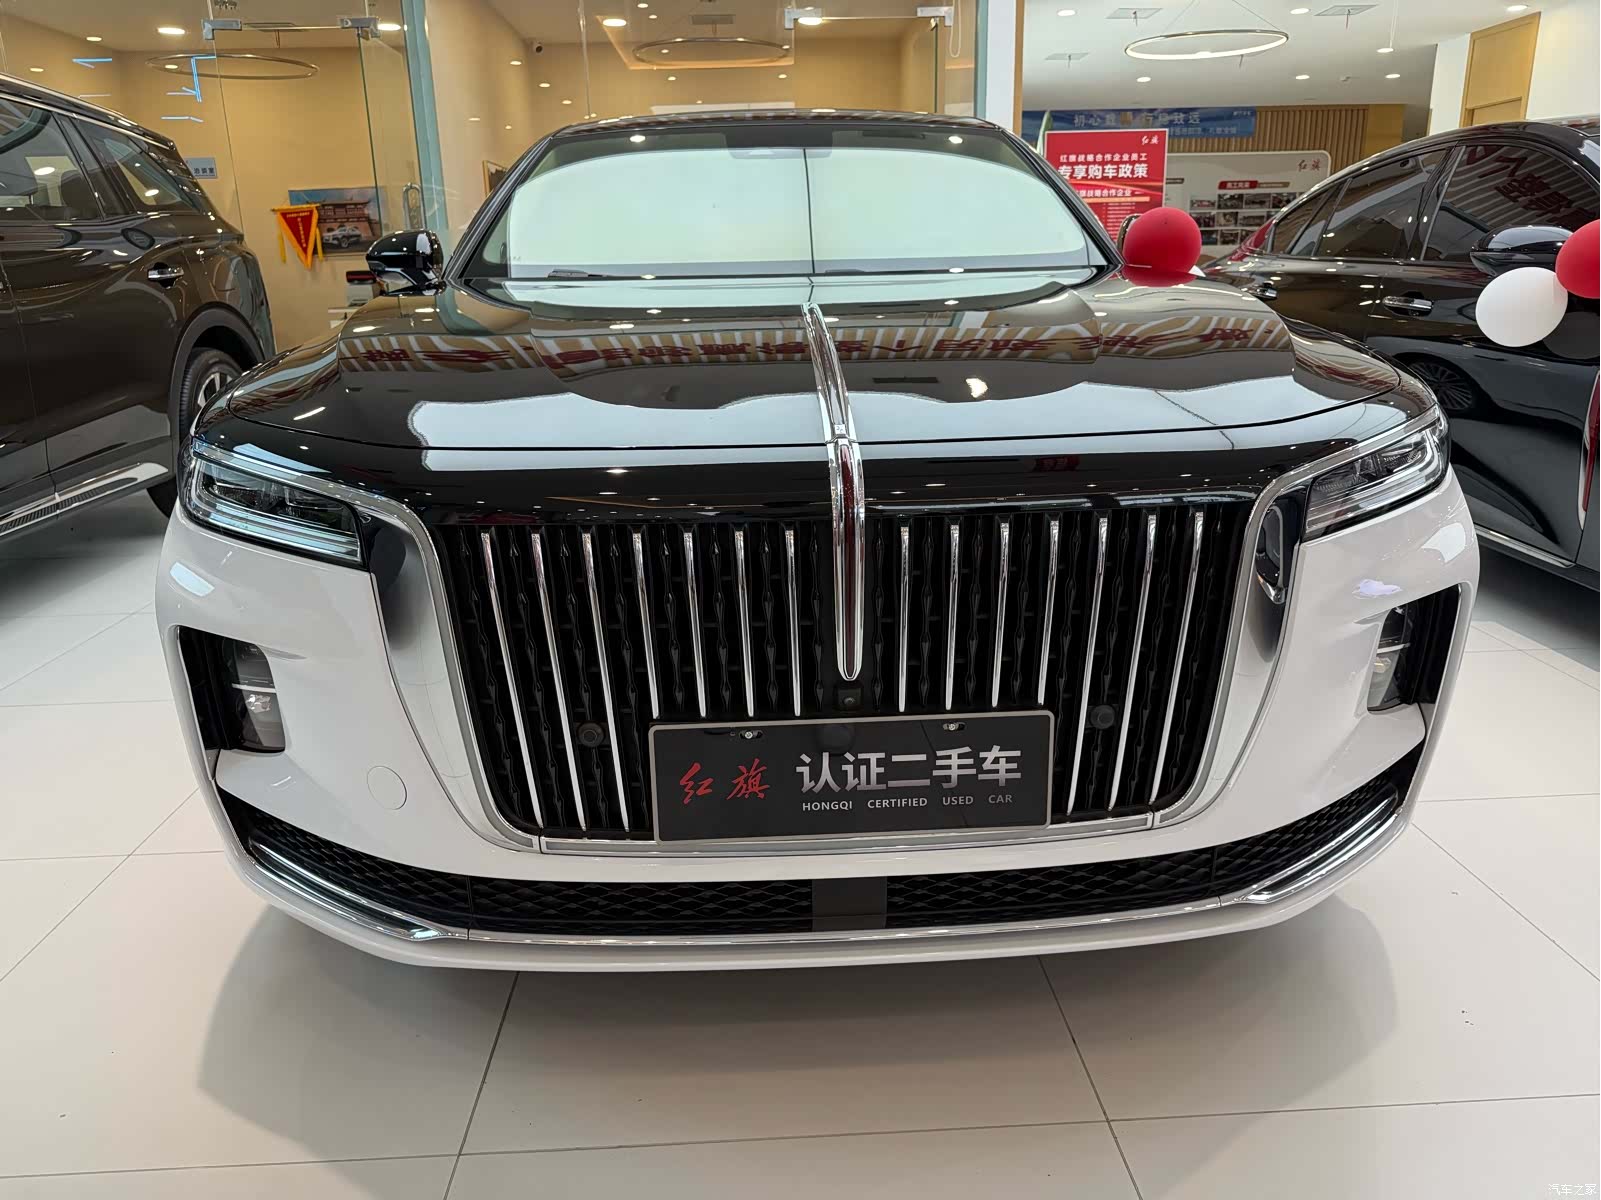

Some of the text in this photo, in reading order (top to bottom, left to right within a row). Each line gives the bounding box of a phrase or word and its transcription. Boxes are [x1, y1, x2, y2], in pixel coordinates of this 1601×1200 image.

[1141, 135, 1159, 145] 红旗
[1059, 153, 1148, 163] 红旗战略合作企业员工
[1057, 163, 1149, 180] 专享购车政策
[796, 744, 1022, 793] 认证二手车
[679, 757, 771, 806] 红旗
[802, 793, 1013, 812] HONGQI CERTIFIED USED CAR
